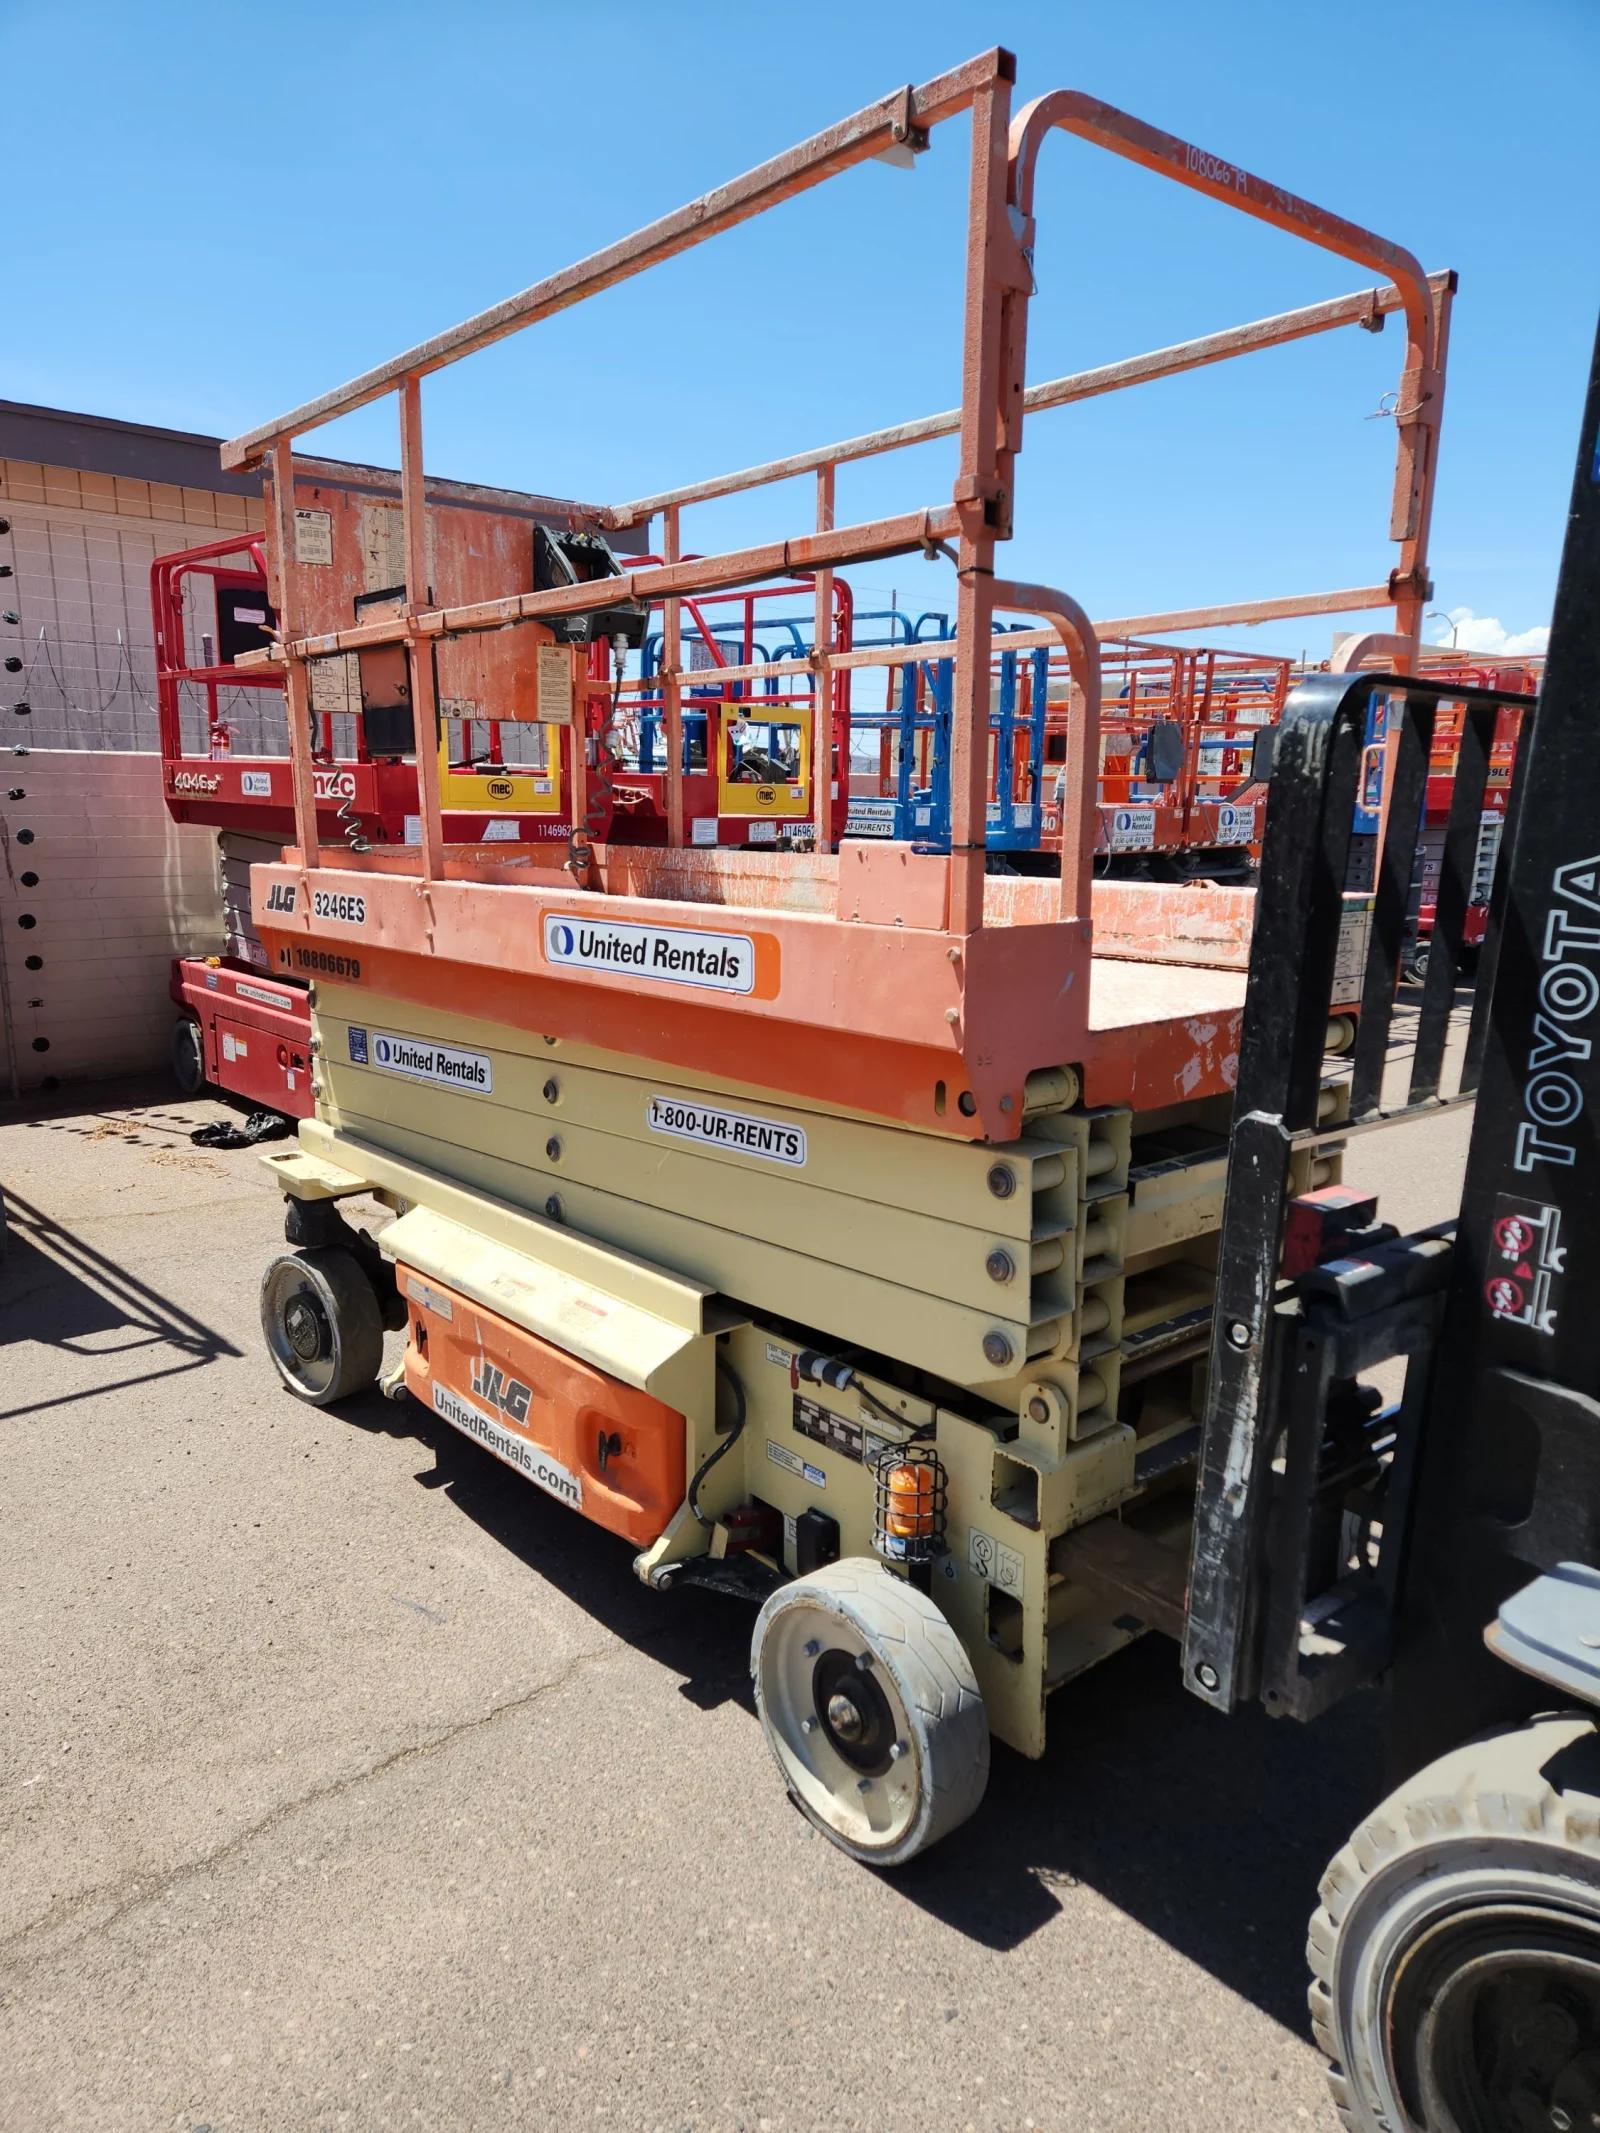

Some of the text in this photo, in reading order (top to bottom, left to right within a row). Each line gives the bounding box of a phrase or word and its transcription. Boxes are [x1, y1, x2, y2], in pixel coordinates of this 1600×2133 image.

[1186, 144, 1247, 194] 10806679
[491, 784, 510, 794] mec
[759, 791, 773, 800] mec
[848, 806, 892, 816] nited Rentals
[1132, 813, 1151, 822] United
[1132, 822, 1152, 830] Rentals
[266, 885, 296, 913] JLG
[315, 892, 365, 923] 3246ES
[297, 948, 360, 978] 10806679
[579, 929, 740, 980] United Rentals
[1514, 854, 1600, 1172] TOYOTA
[393, 1044, 433, 1072] United
[437, 1053, 486, 1084] Rentals
[652, 1105, 798, 1157] 1-800-UR-RENTS
[472, 1362, 532, 1425] JLG
[435, 1388, 579, 1498] UnitedRentals.com
